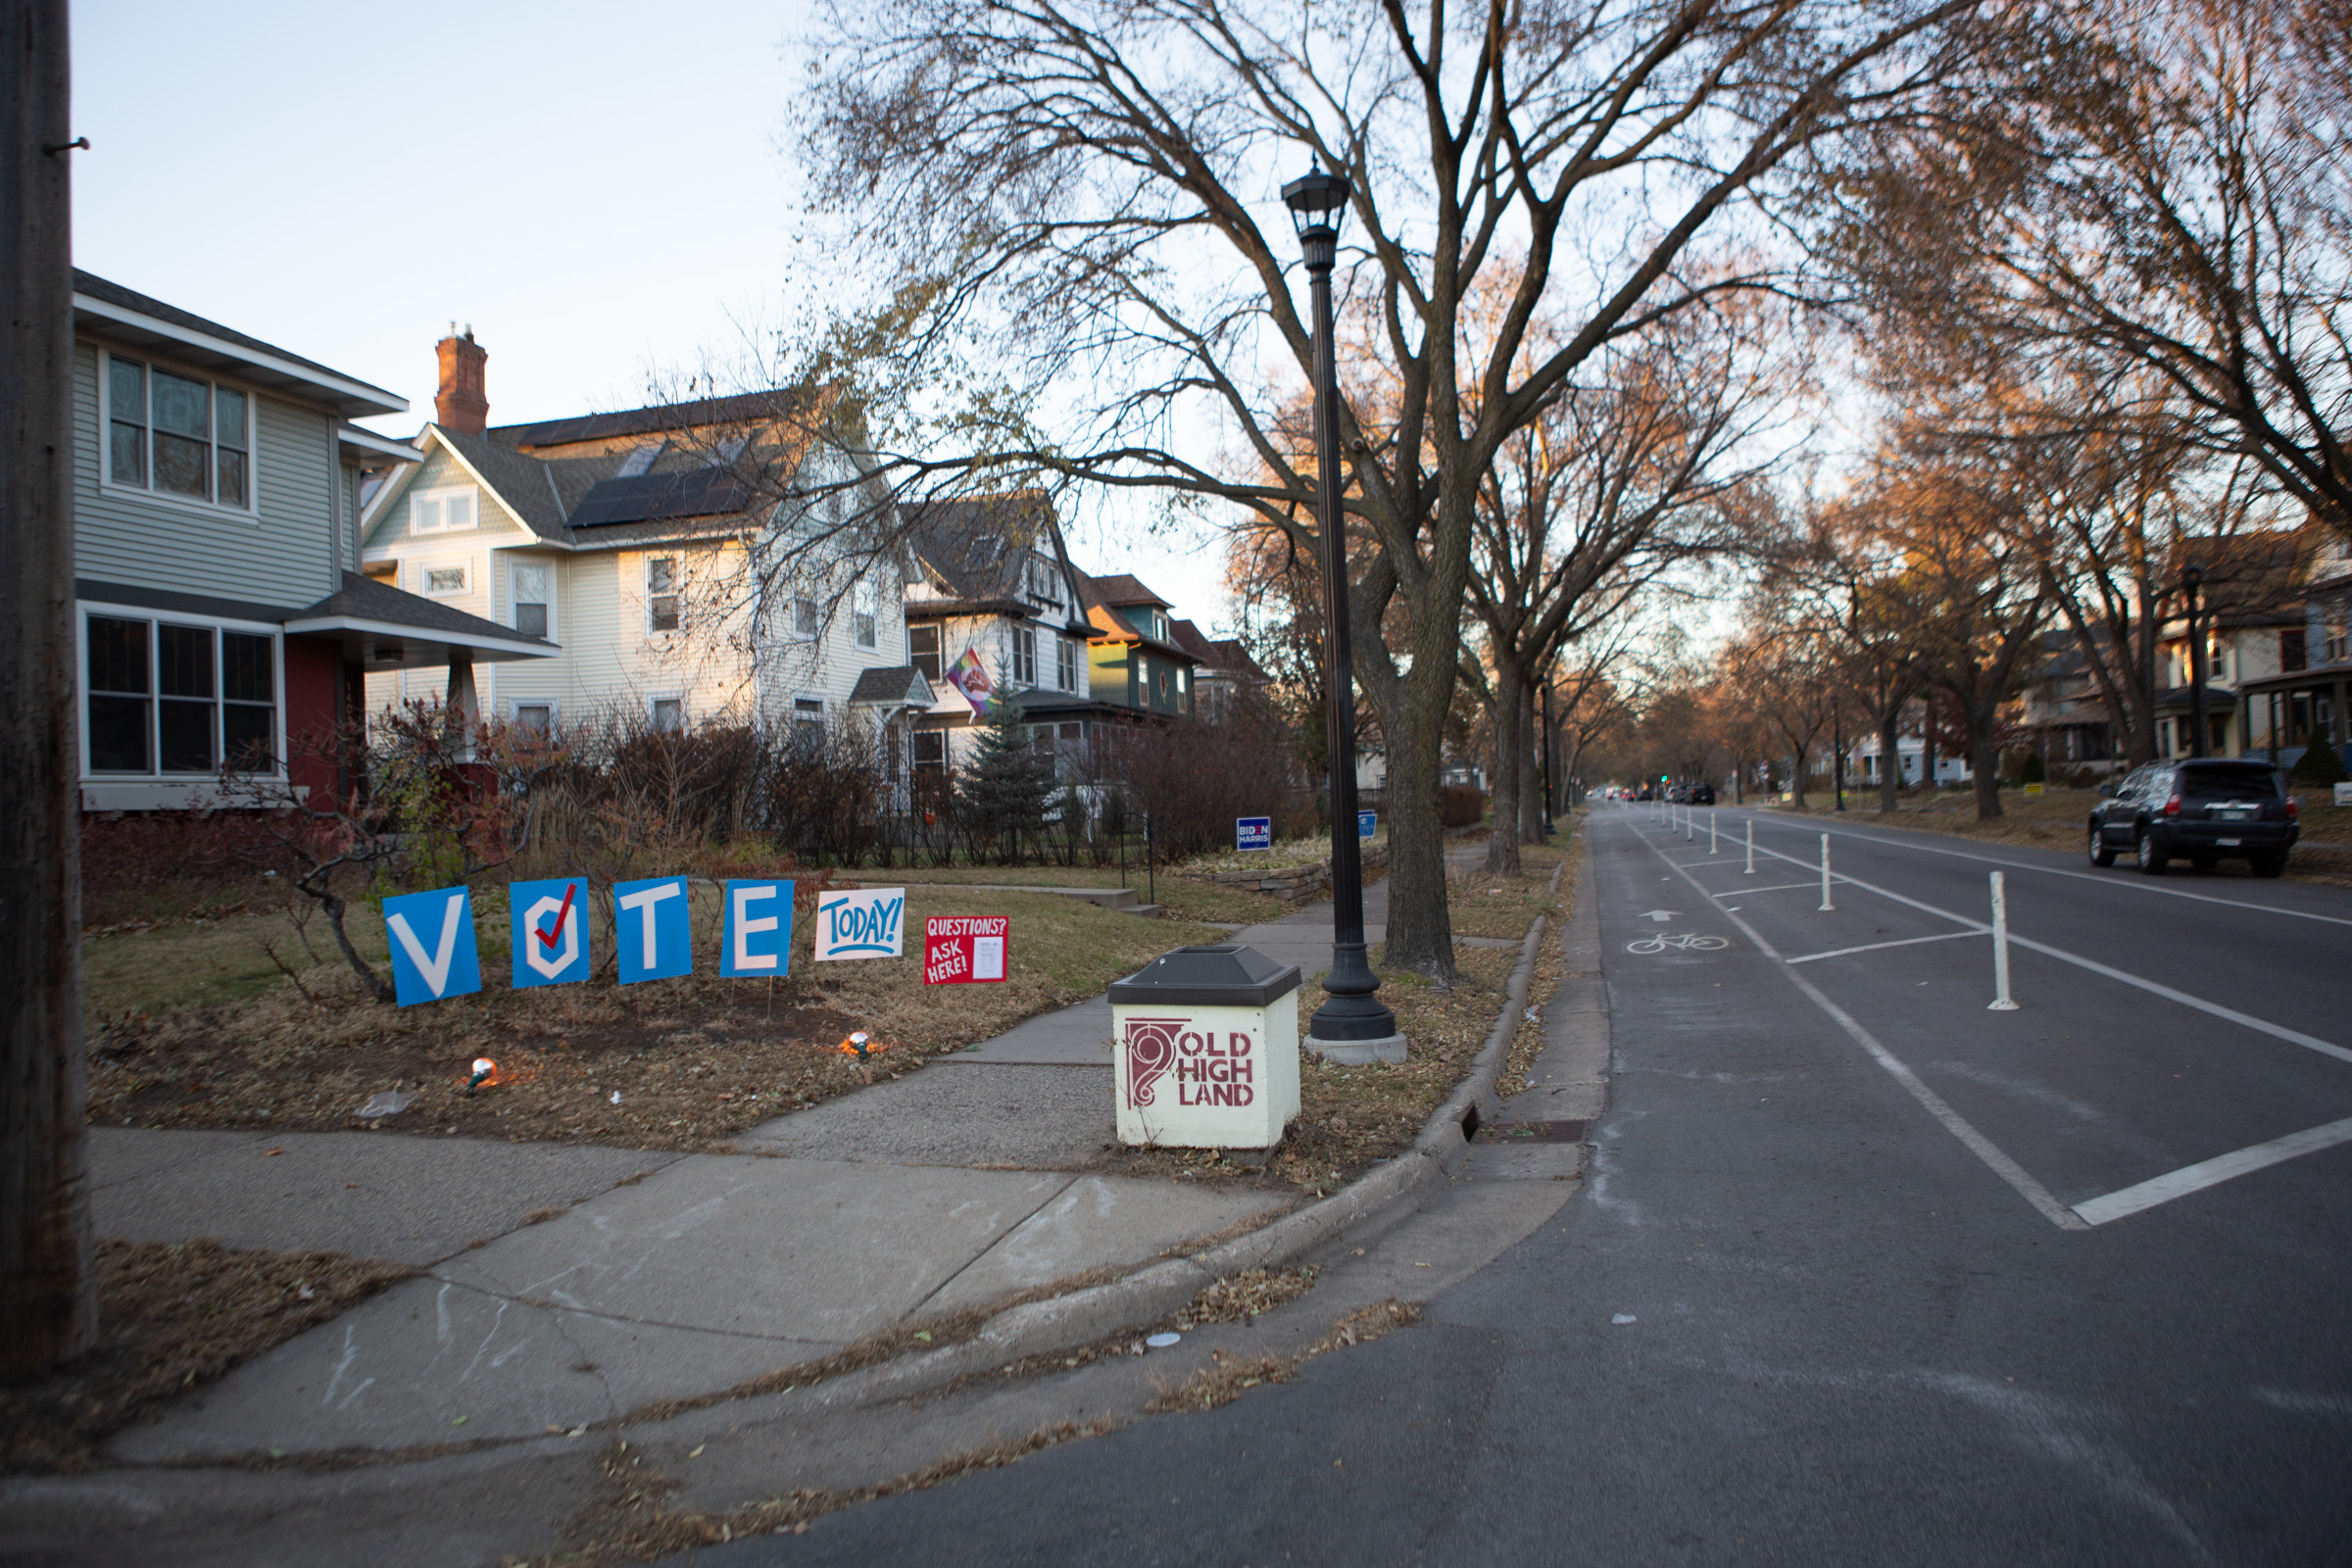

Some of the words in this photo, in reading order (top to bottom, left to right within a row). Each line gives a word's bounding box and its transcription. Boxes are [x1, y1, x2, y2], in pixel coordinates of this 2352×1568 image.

[1239, 825, 1268, 835] BIDEN
[819, 897, 904, 944] TODAY!
[927, 918, 1006, 936] QUESTIONS?
[931, 938, 963, 963] ASK
[927, 956, 968, 984] HERE!
[1179, 1032, 1250, 1056] OLD
[1178, 1058, 1252, 1083] HIGH
[1179, 1083, 1253, 1106] LAND
